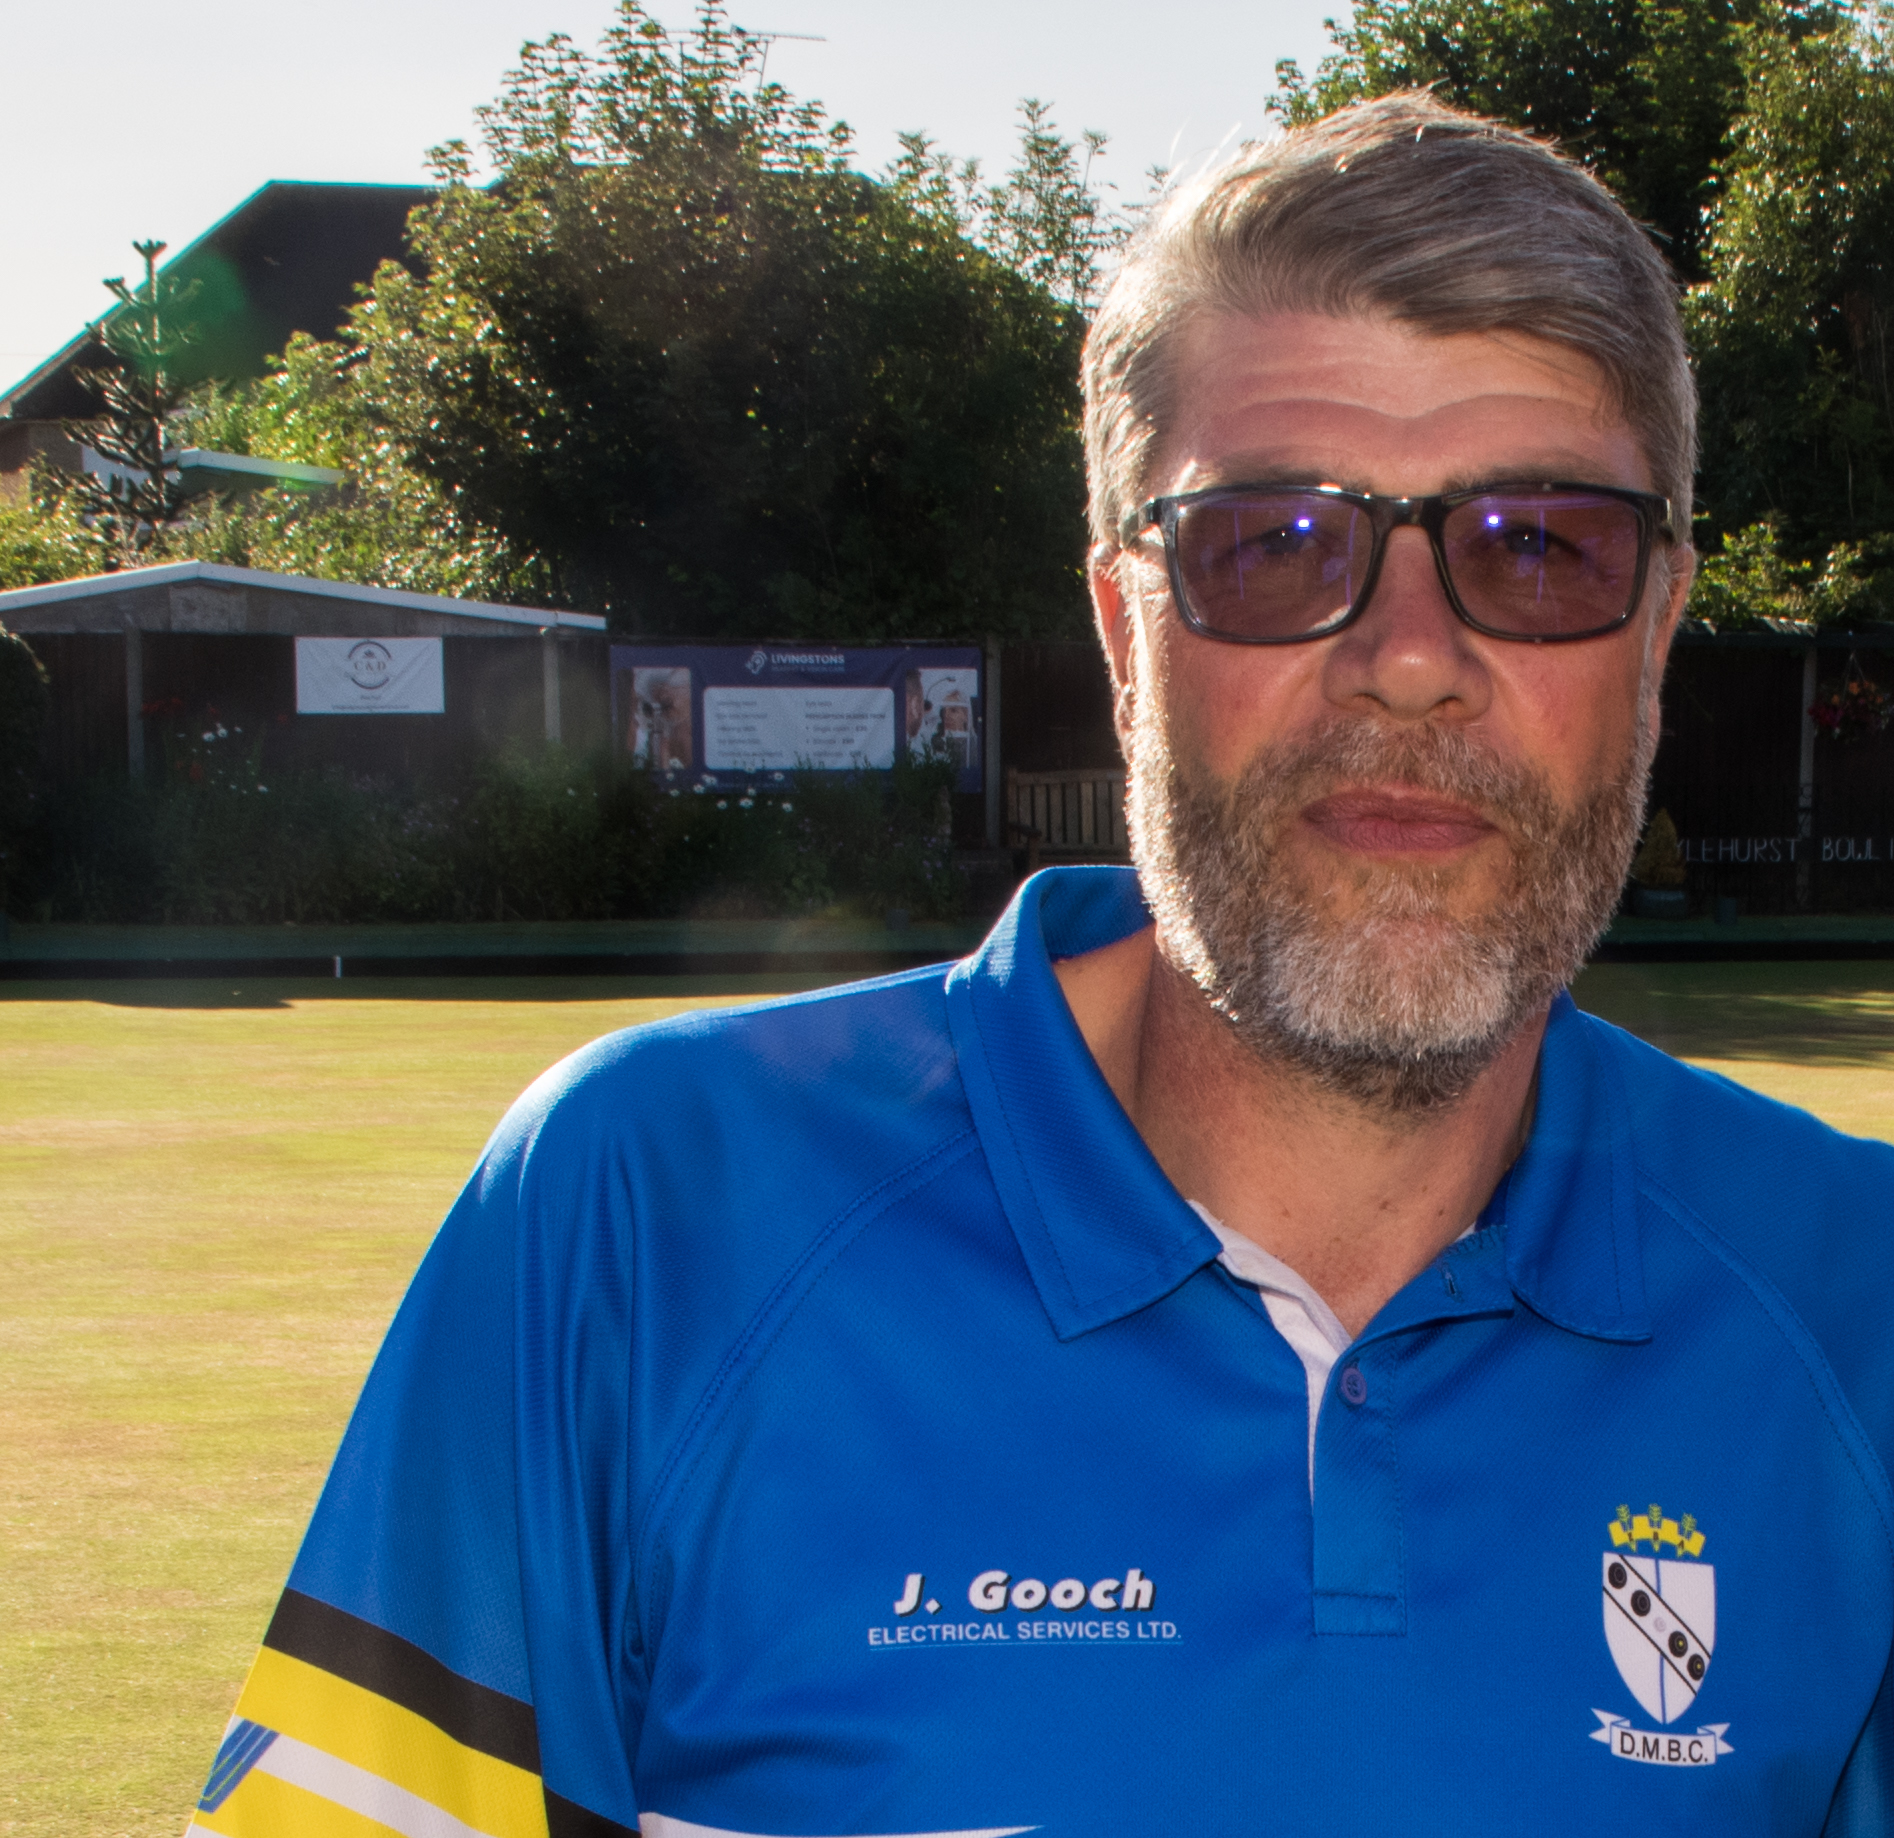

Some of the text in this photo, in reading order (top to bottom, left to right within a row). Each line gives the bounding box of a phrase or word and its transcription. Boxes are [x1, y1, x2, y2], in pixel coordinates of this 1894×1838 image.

[771, 653, 845, 664] LIVINGSTONS
[1675, 837, 1802, 863] YLEHURST
[894, 1567, 1157, 1617] J. Gooch
[868, 1620, 1182, 1646] ELECTRICAL SERVICES LTD.
[1620, 1731, 1708, 1763] D.M.B.C.
